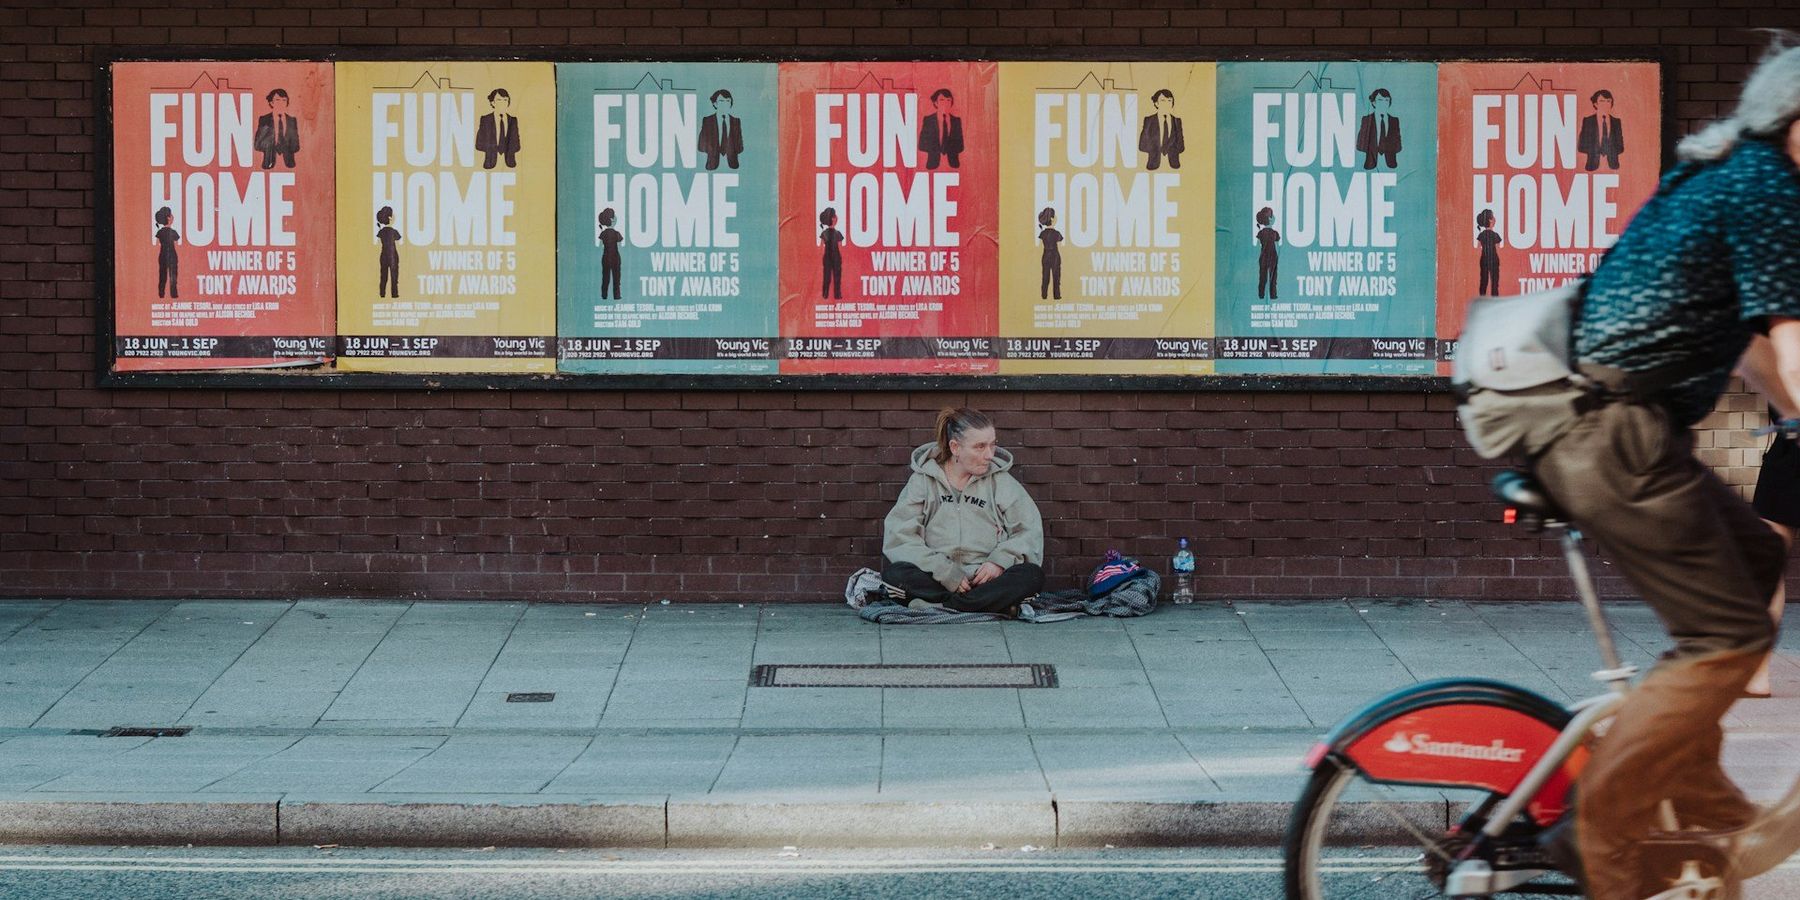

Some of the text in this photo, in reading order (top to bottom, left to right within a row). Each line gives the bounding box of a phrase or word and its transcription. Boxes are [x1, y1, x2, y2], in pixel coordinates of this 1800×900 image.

[150, 93, 253, 167] FUN
[374, 93, 475, 167] FUN
[594, 94, 697, 168] FUN
[816, 94, 918, 168] FUN
[1036, 94, 1139, 168] FUN
[1253, 93, 1356, 168] FUN
[1473, 94, 1577, 169] FUN
[152, 172, 295, 247] HOME
[374, 172, 516, 246] HOME
[595, 173, 739, 248] HOME
[816, 172, 960, 248] HOME
[1036, 173, 1180, 248] HOME
[1253, 172, 1397, 248] HOME
[1473, 174, 1619, 249] HOME
[207, 251, 295, 271] WINNER OF 5
[428, 251, 516, 271] WINNER OF 5
[650, 252, 739, 272] WINNER OF 5
[872, 252, 959, 272] WINNER OF 5
[1091, 252, 1179, 272] WINNER OF 5
[1308, 252, 1396, 272] WINNER OF 5
[1530, 254, 1585, 274] WINNER
[197, 275, 296, 295] TONY AWARDS
[418, 275, 516, 295] TONY AWARDS
[640, 276, 739, 296] TONY AWARDS
[861, 276, 960, 296] TONY AWARDS
[1080, 276, 1180, 296] TONY AWARDS
[1297, 276, 1396, 296] TONY AWARDS
[1519, 278, 1555, 296] TONY
[124, 338, 140, 349] 18
[142, 338, 168, 349] JUN
[182, 338, 189, 349] 1
[193, 338, 218, 349] SEP
[273, 337, 326, 351] Young Vic
[346, 338, 360, 349] 18
[363, 338, 389, 349] JUN
[402, 338, 409, 349] 1
[413, 338, 438, 349] SEP
[492, 337, 545, 351] Young Vic
[567, 340, 582, 351] 18
[585, 340, 611, 351] JUN
[624, 340, 632, 351] 1
[636, 340, 661, 351] SEP
[716, 339, 769, 352] Young Vic
[788, 339, 803, 351] 18
[806, 339, 832, 350] JUN
[845, 339, 853, 350] 1
[856, 339, 882, 350] SEP
[936, 338, 989, 352] Young Vic
[1007, 340, 1022, 351] 18
[1024, 340, 1051, 351] JUN
[1064, 340, 1071, 351] 1
[1075, 340, 1101, 351] SEP
[1155, 339, 1209, 352] Young Vic
[1224, 339, 1238, 351] 18
[1241, 339, 1268, 351] JUN
[1281, 340, 1288, 351] 1
[1292, 339, 1318, 351] SEP
[1372, 339, 1425, 352] Young Vic
[1410, 734, 1526, 762] Santander
